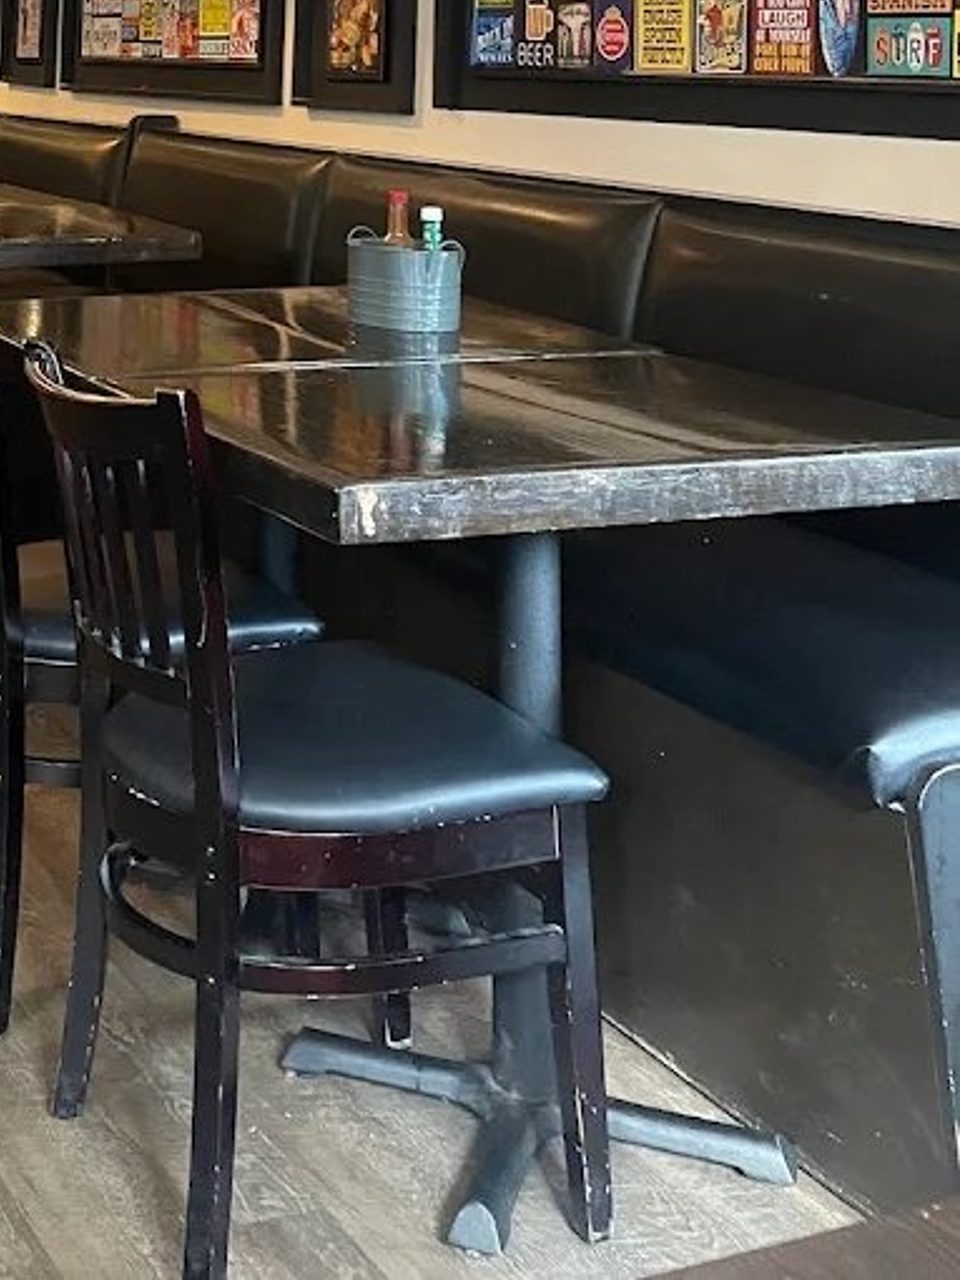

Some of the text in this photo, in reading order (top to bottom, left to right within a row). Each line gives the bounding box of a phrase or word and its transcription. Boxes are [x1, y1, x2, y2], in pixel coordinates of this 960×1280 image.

[761, 11, 806, 26] LAUGH
[517, 41, 554, 67] BEER
[875, 30, 942, 67] SURF
